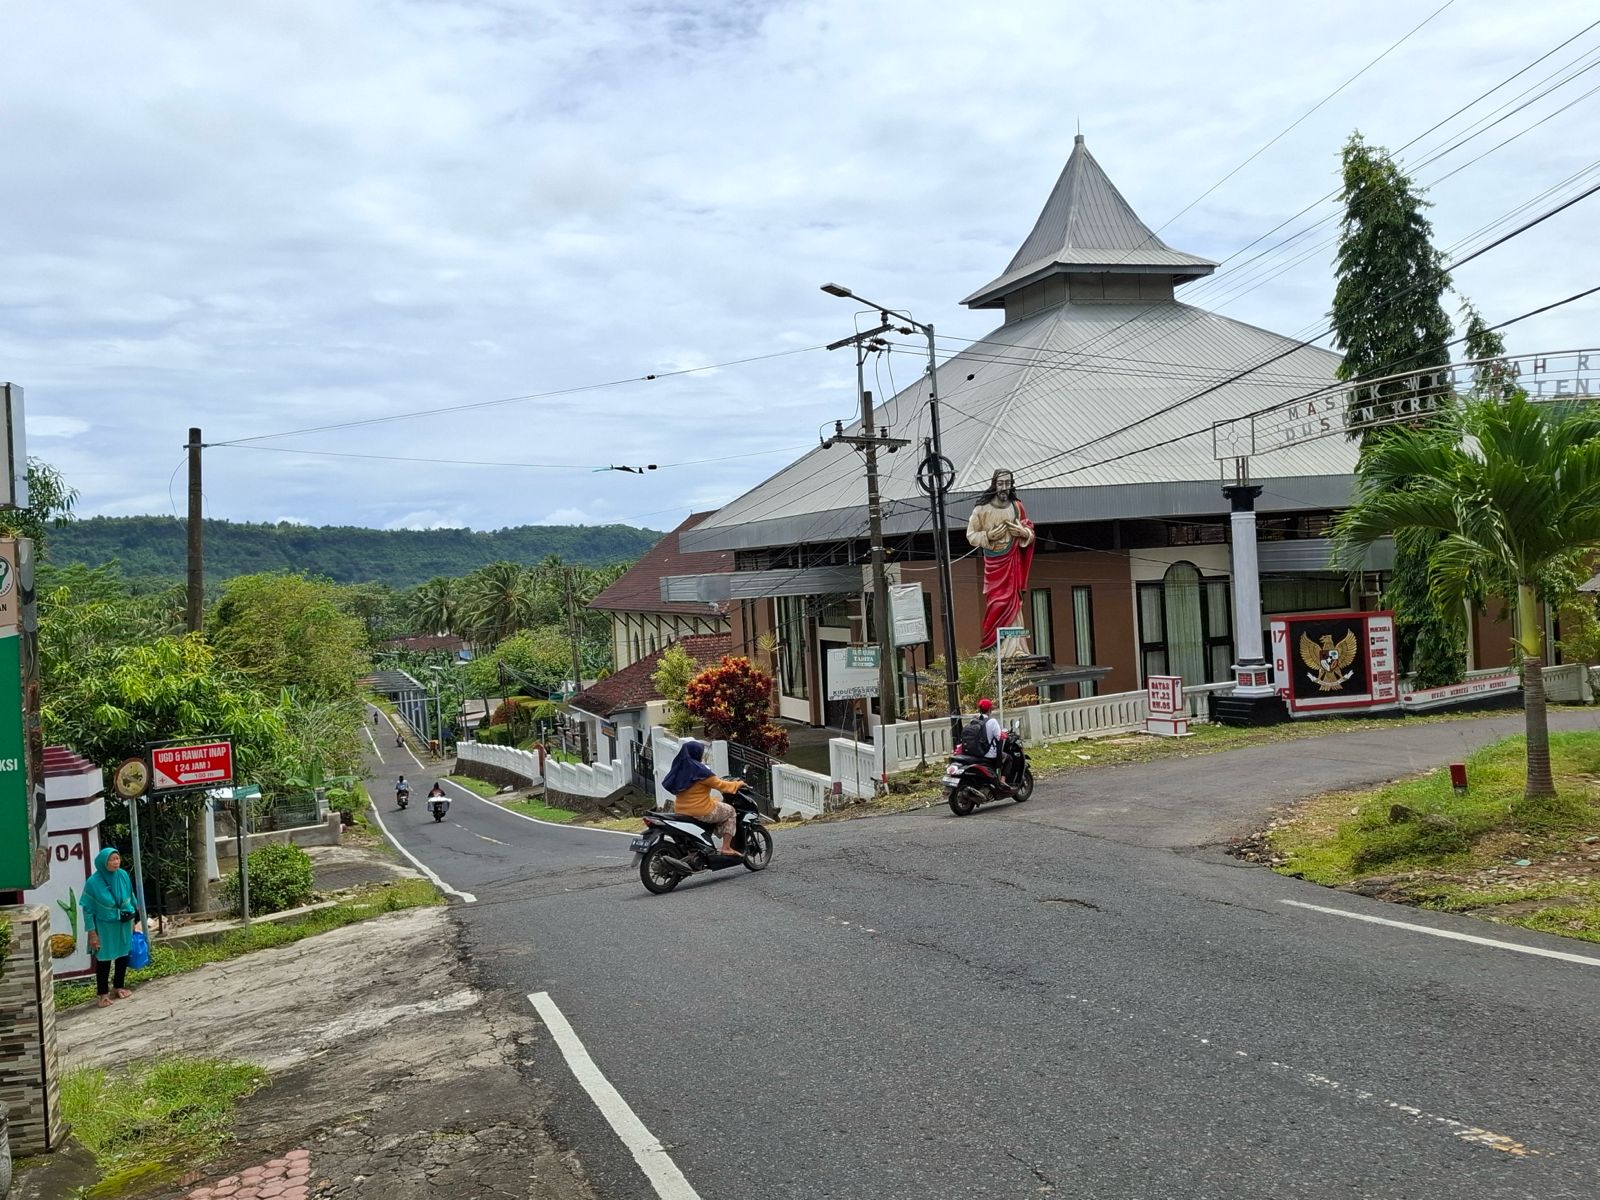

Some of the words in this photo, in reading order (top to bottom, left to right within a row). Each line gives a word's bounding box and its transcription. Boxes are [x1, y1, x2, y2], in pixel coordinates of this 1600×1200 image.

[1285, 405, 1375, 441] DUSUN
[1534, 378, 1600, 397] TEN
[1288, 384, 1382, 421] MASUK
[1273, 630, 1286, 643] 17
[1276, 658, 1284, 671] 8
[158, 752, 174, 763] UGD
[175, 751, 181, 761] &
[181, 749, 208, 760] RAWAT
[209, 746, 226, 758] INAP
